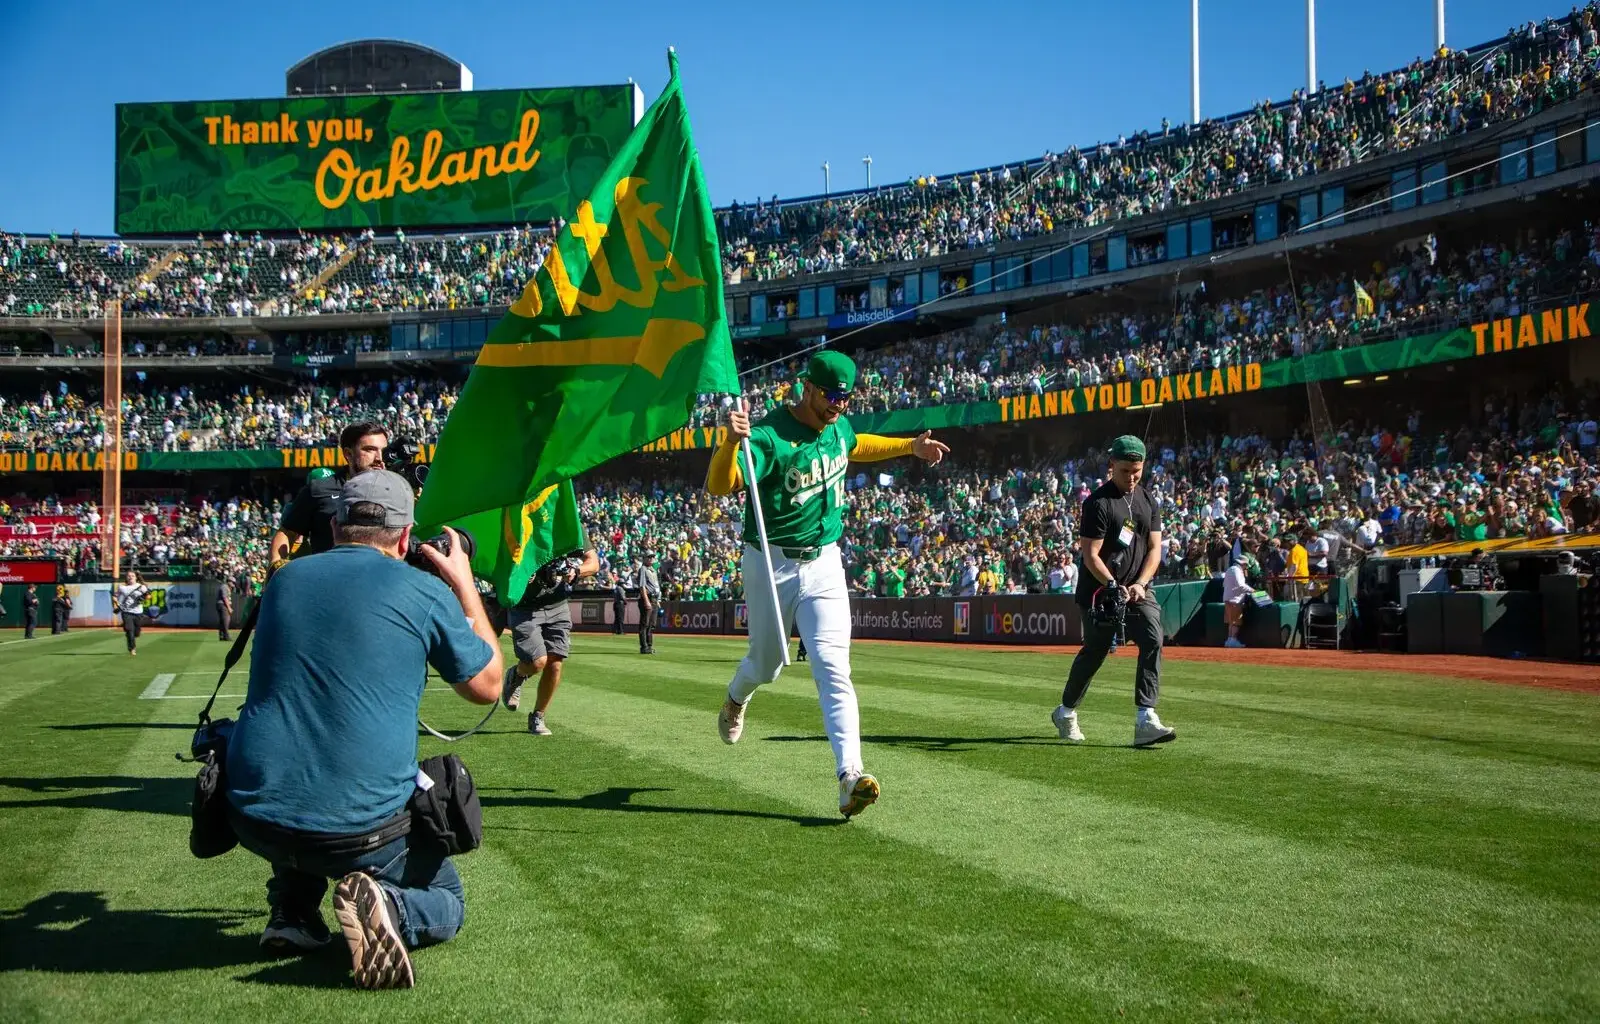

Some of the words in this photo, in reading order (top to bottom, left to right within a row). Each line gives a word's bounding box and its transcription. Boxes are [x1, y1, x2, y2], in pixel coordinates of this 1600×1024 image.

[204, 113, 299, 145] Thank
[306, 118, 373, 148] you,
[315, 109, 541, 209] Oakland
[1471, 303, 1591, 356] THANK
[998, 388, 1076, 422] THANK
[1083, 381, 1132, 412] YOU
[1141, 362, 1262, 405] OAKLAND
[785, 437, 849, 493] Oakland
[850, 609, 889, 628] olutions
[891, 611, 900, 628] &
[902, 610, 943, 629] Services
[985, 602, 1067, 636] ubeo.com
